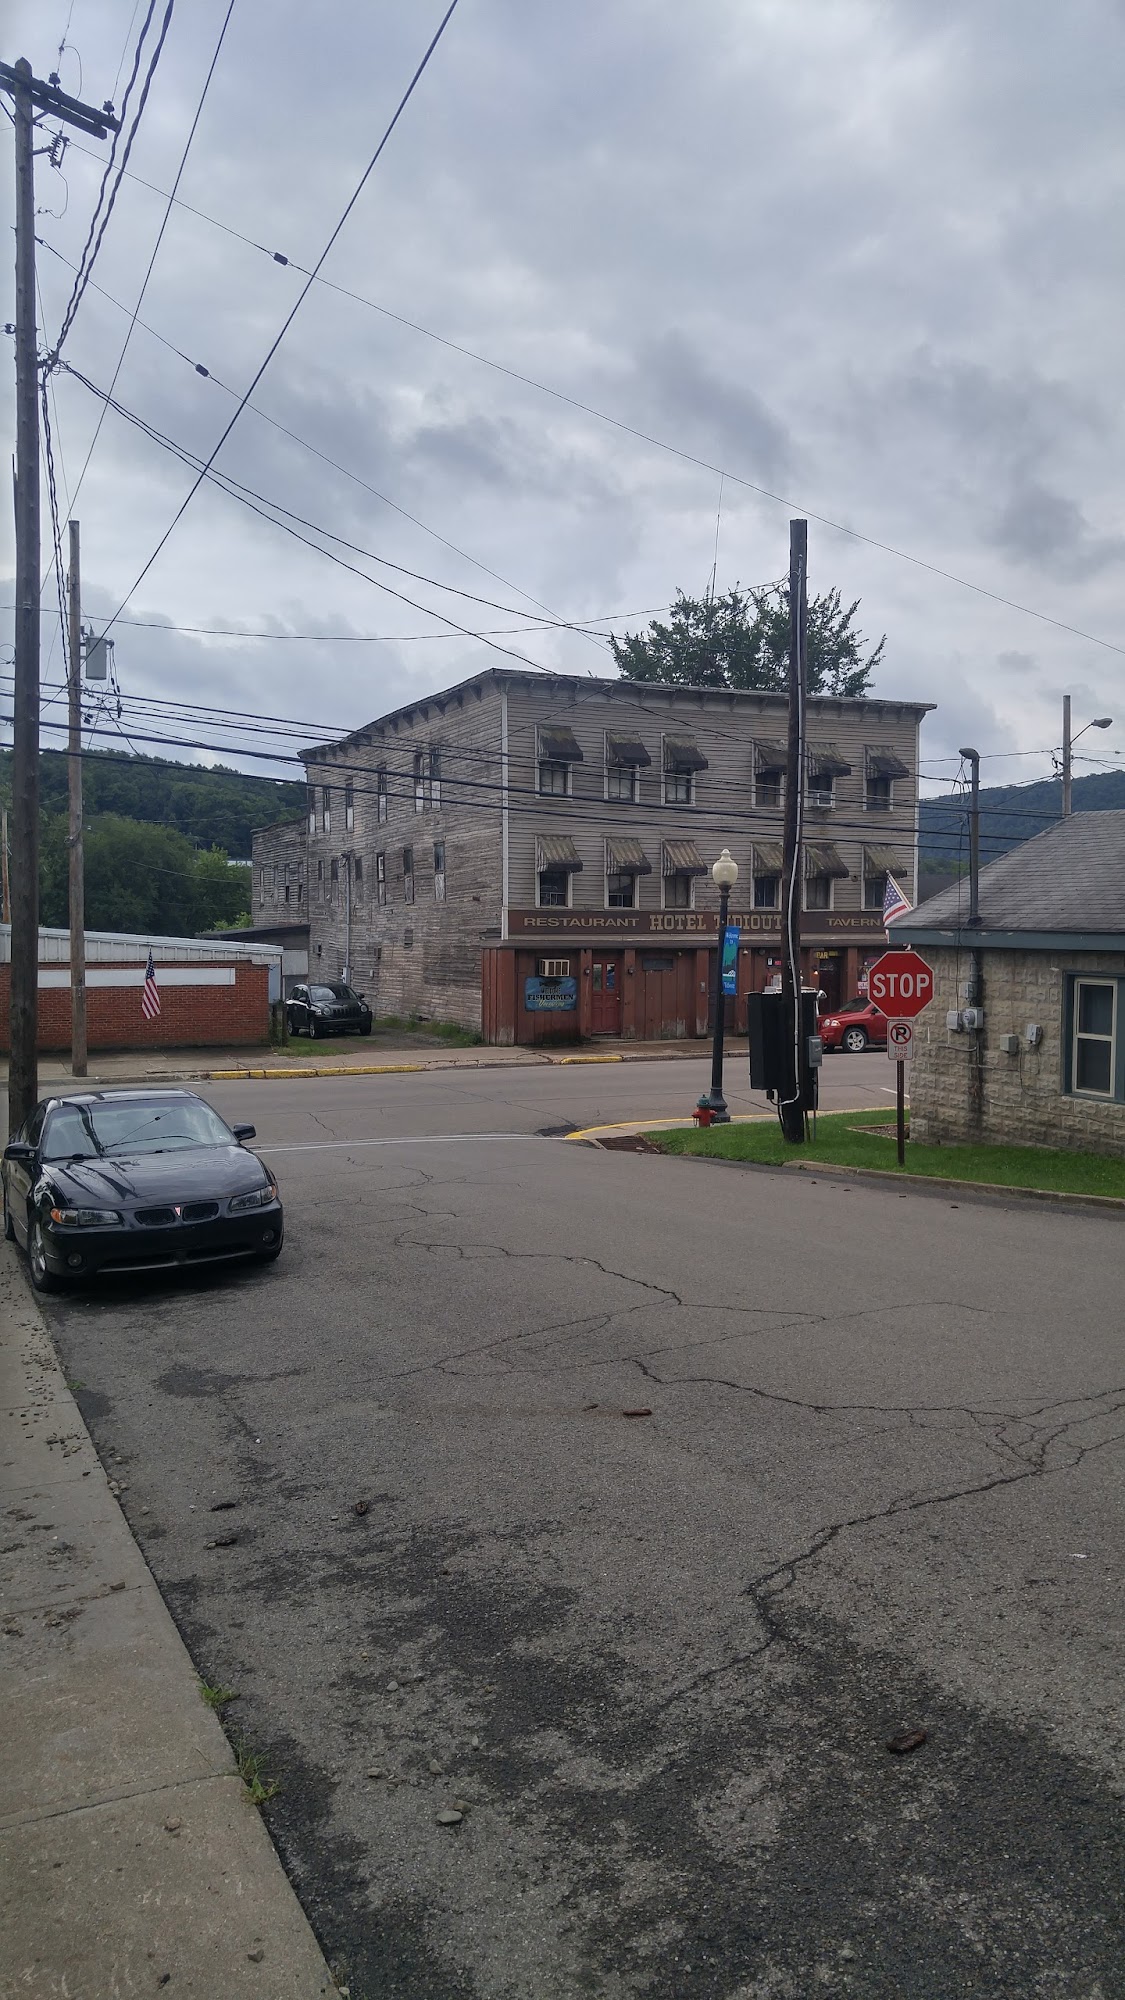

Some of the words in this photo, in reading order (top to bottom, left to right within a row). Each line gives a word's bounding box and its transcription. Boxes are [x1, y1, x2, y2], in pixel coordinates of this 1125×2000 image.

[523, 917, 640, 927] RESTAURANT
[649, 914, 707, 930] HOTEL
[826, 918, 881, 927] TAVERN
[872, 973, 930, 998] STOP
